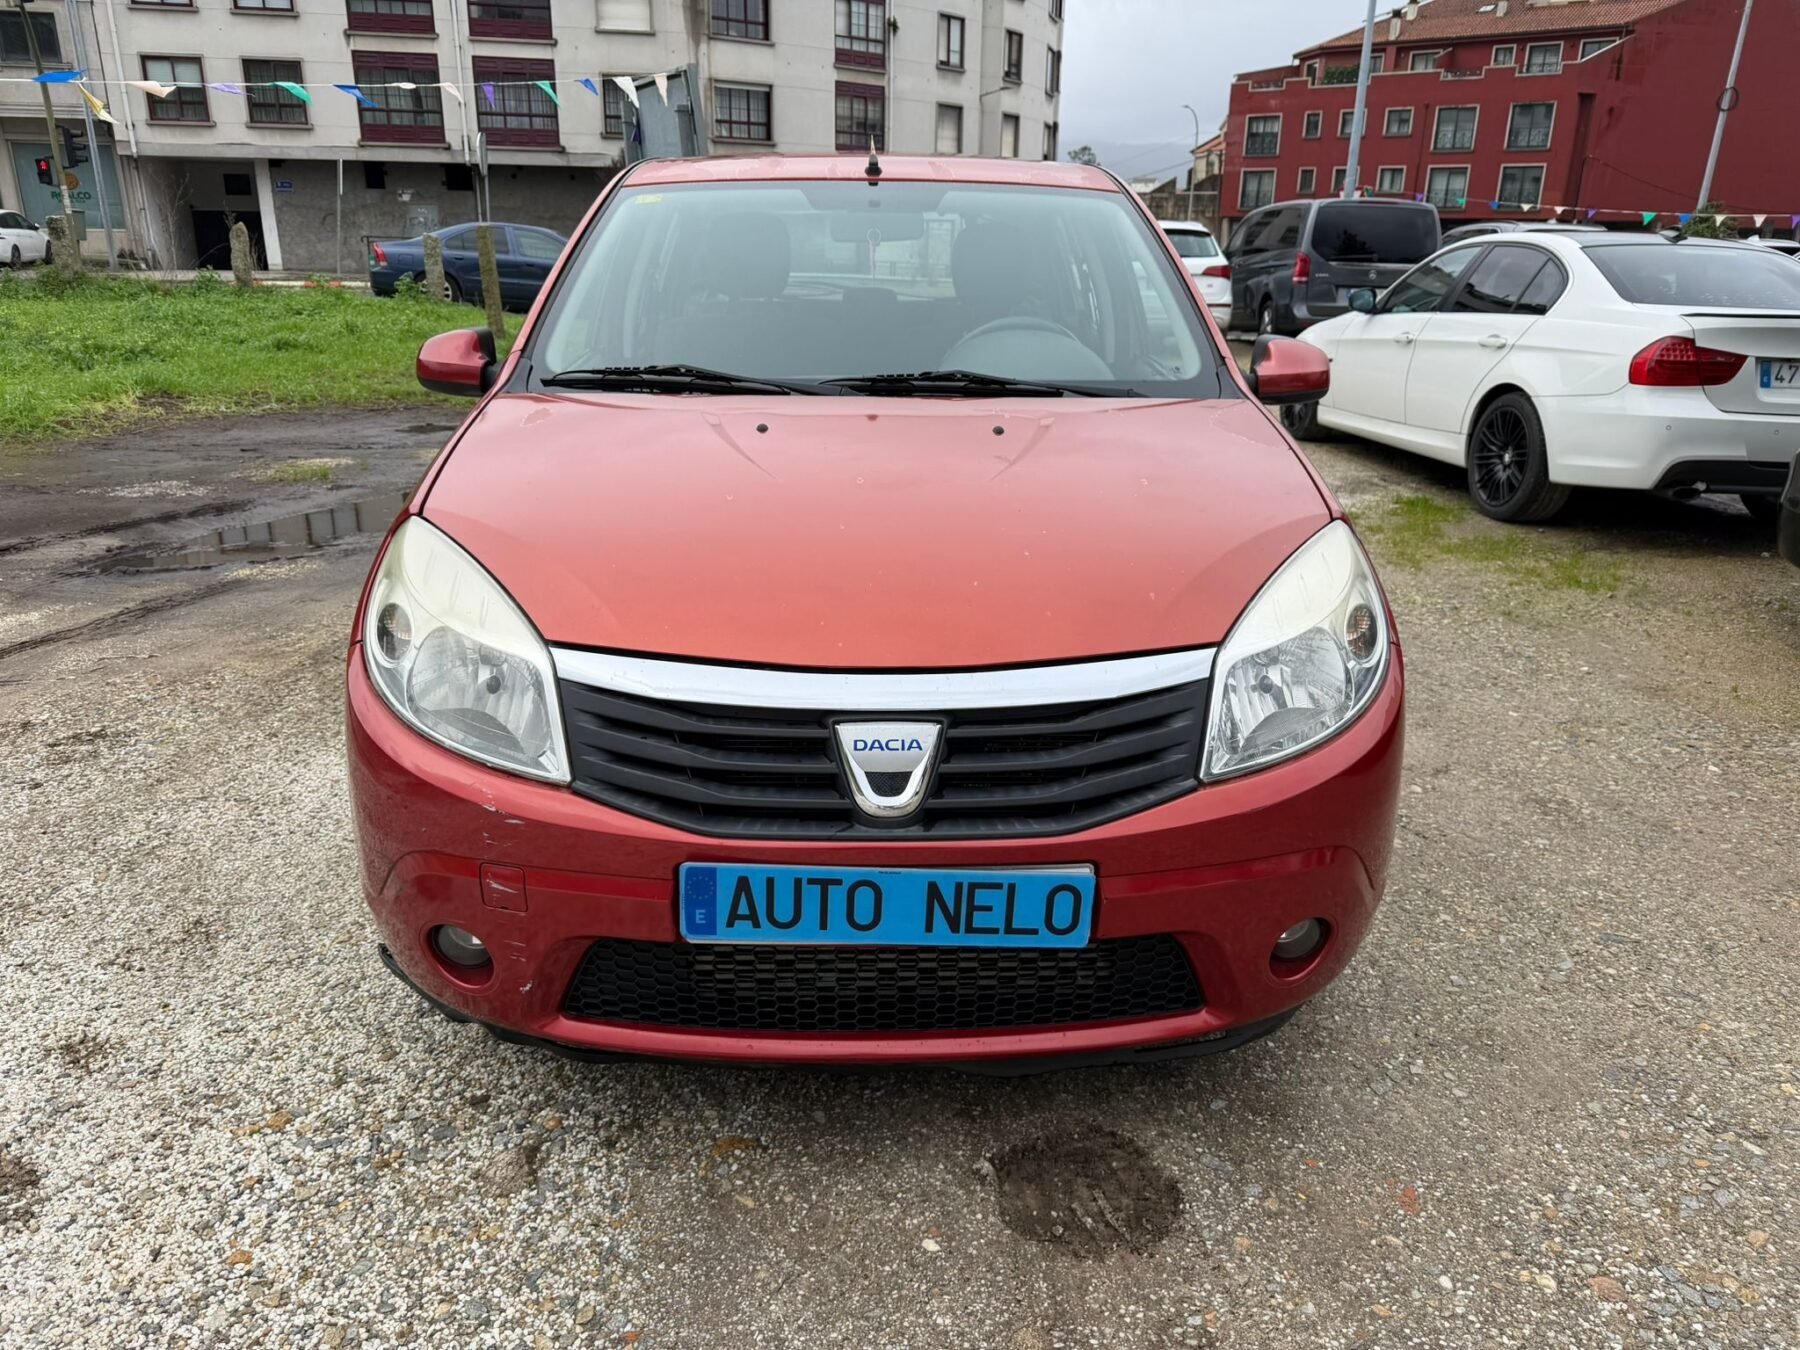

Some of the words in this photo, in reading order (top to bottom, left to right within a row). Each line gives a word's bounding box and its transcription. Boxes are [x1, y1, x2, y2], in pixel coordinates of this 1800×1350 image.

[1774, 363, 1800, 384] 47
[853, 739, 923, 751] DACIA
[695, 909, 707, 924] E
[725, 875, 883, 932] AUTO
[924, 880, 1082, 936] NELO
